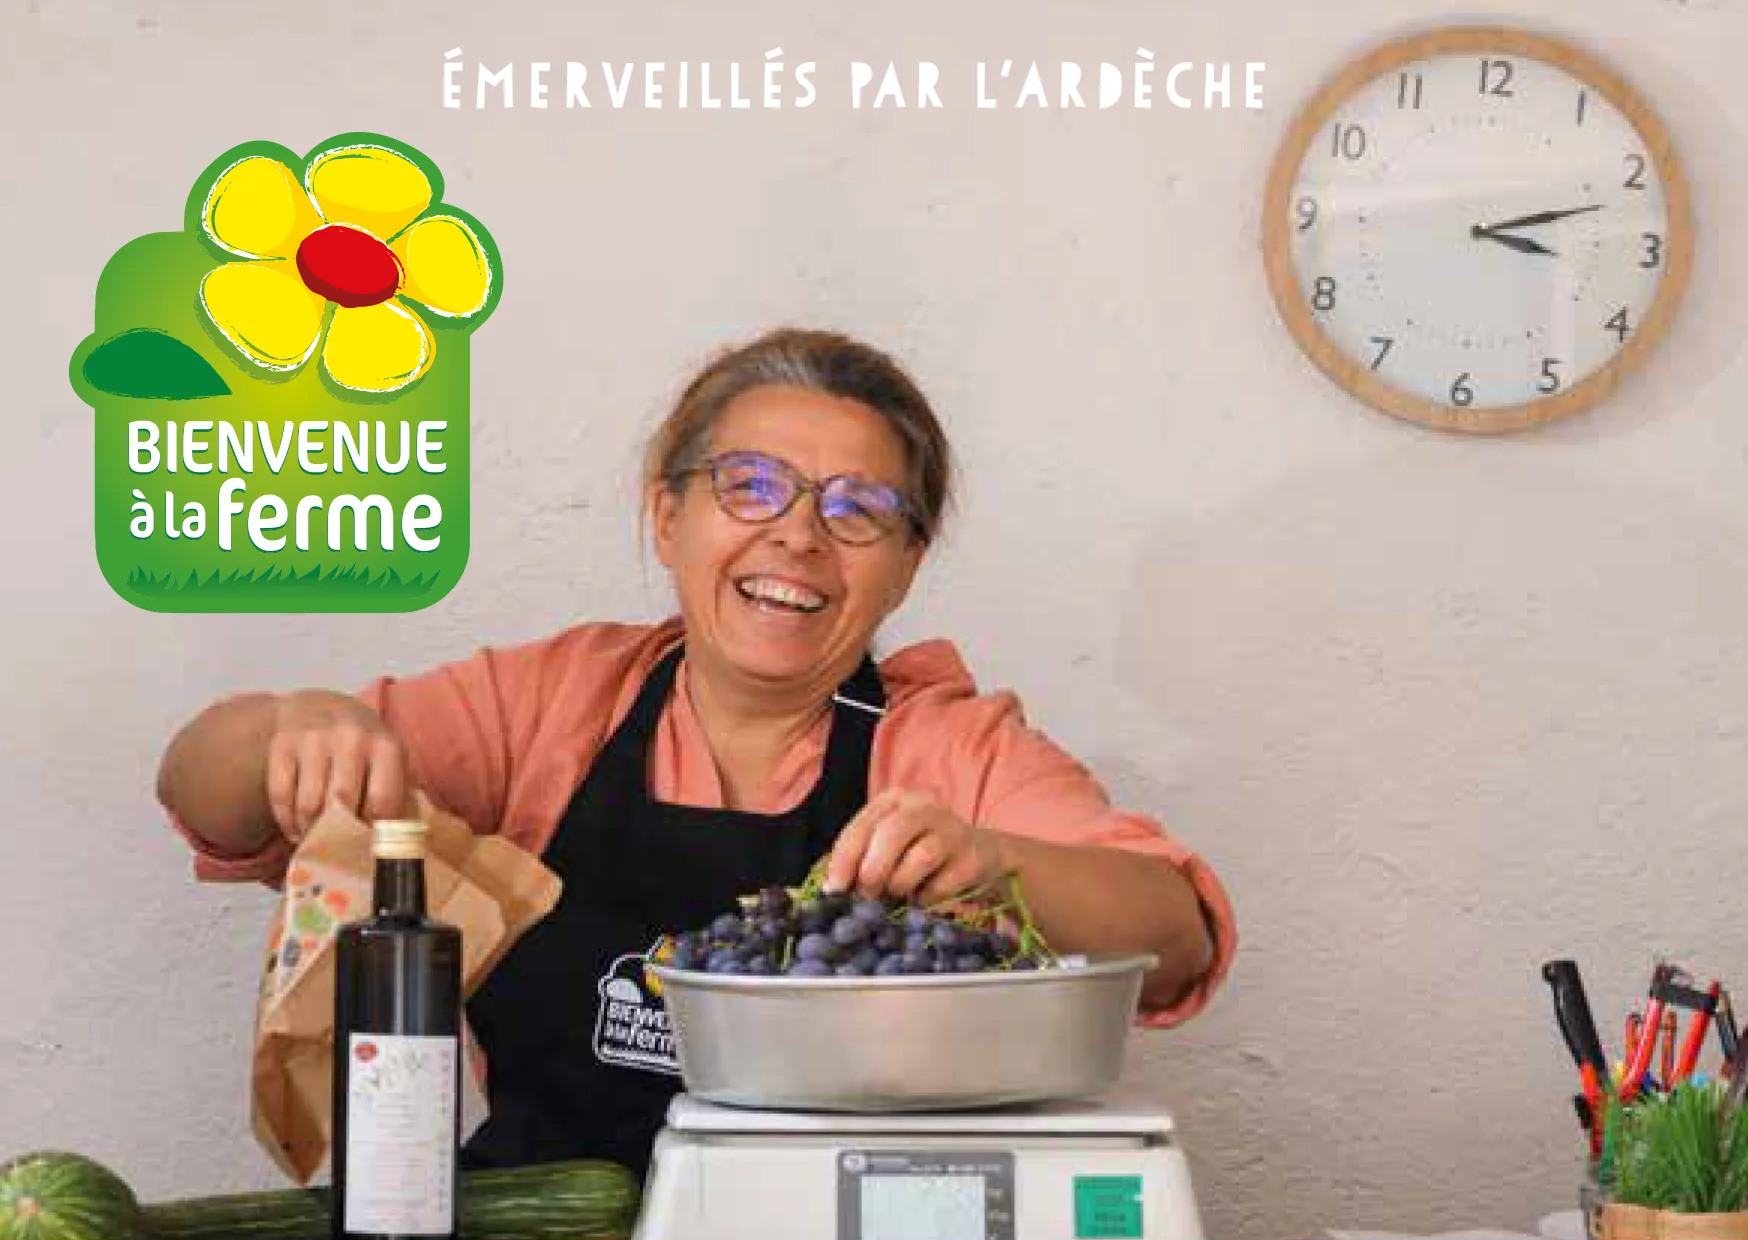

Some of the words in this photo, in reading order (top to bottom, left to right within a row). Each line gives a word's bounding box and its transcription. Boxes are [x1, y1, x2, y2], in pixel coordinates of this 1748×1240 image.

[1397, 72, 1423, 109] 11
[1479, 60, 1514, 97] 12
[1576, 86, 1588, 126] 1
[1332, 123, 1366, 160] 10
[1623, 154, 1645, 190] 2
[1296, 196, 1317, 232] 9
[1639, 233, 1660, 268] 3
[1312, 276, 1336, 311] 8
[1605, 306, 1630, 343] 4
[1370, 336, 1393, 370] 7
[1450, 373, 1473, 406] 6
[1538, 358, 1561, 393] 5
